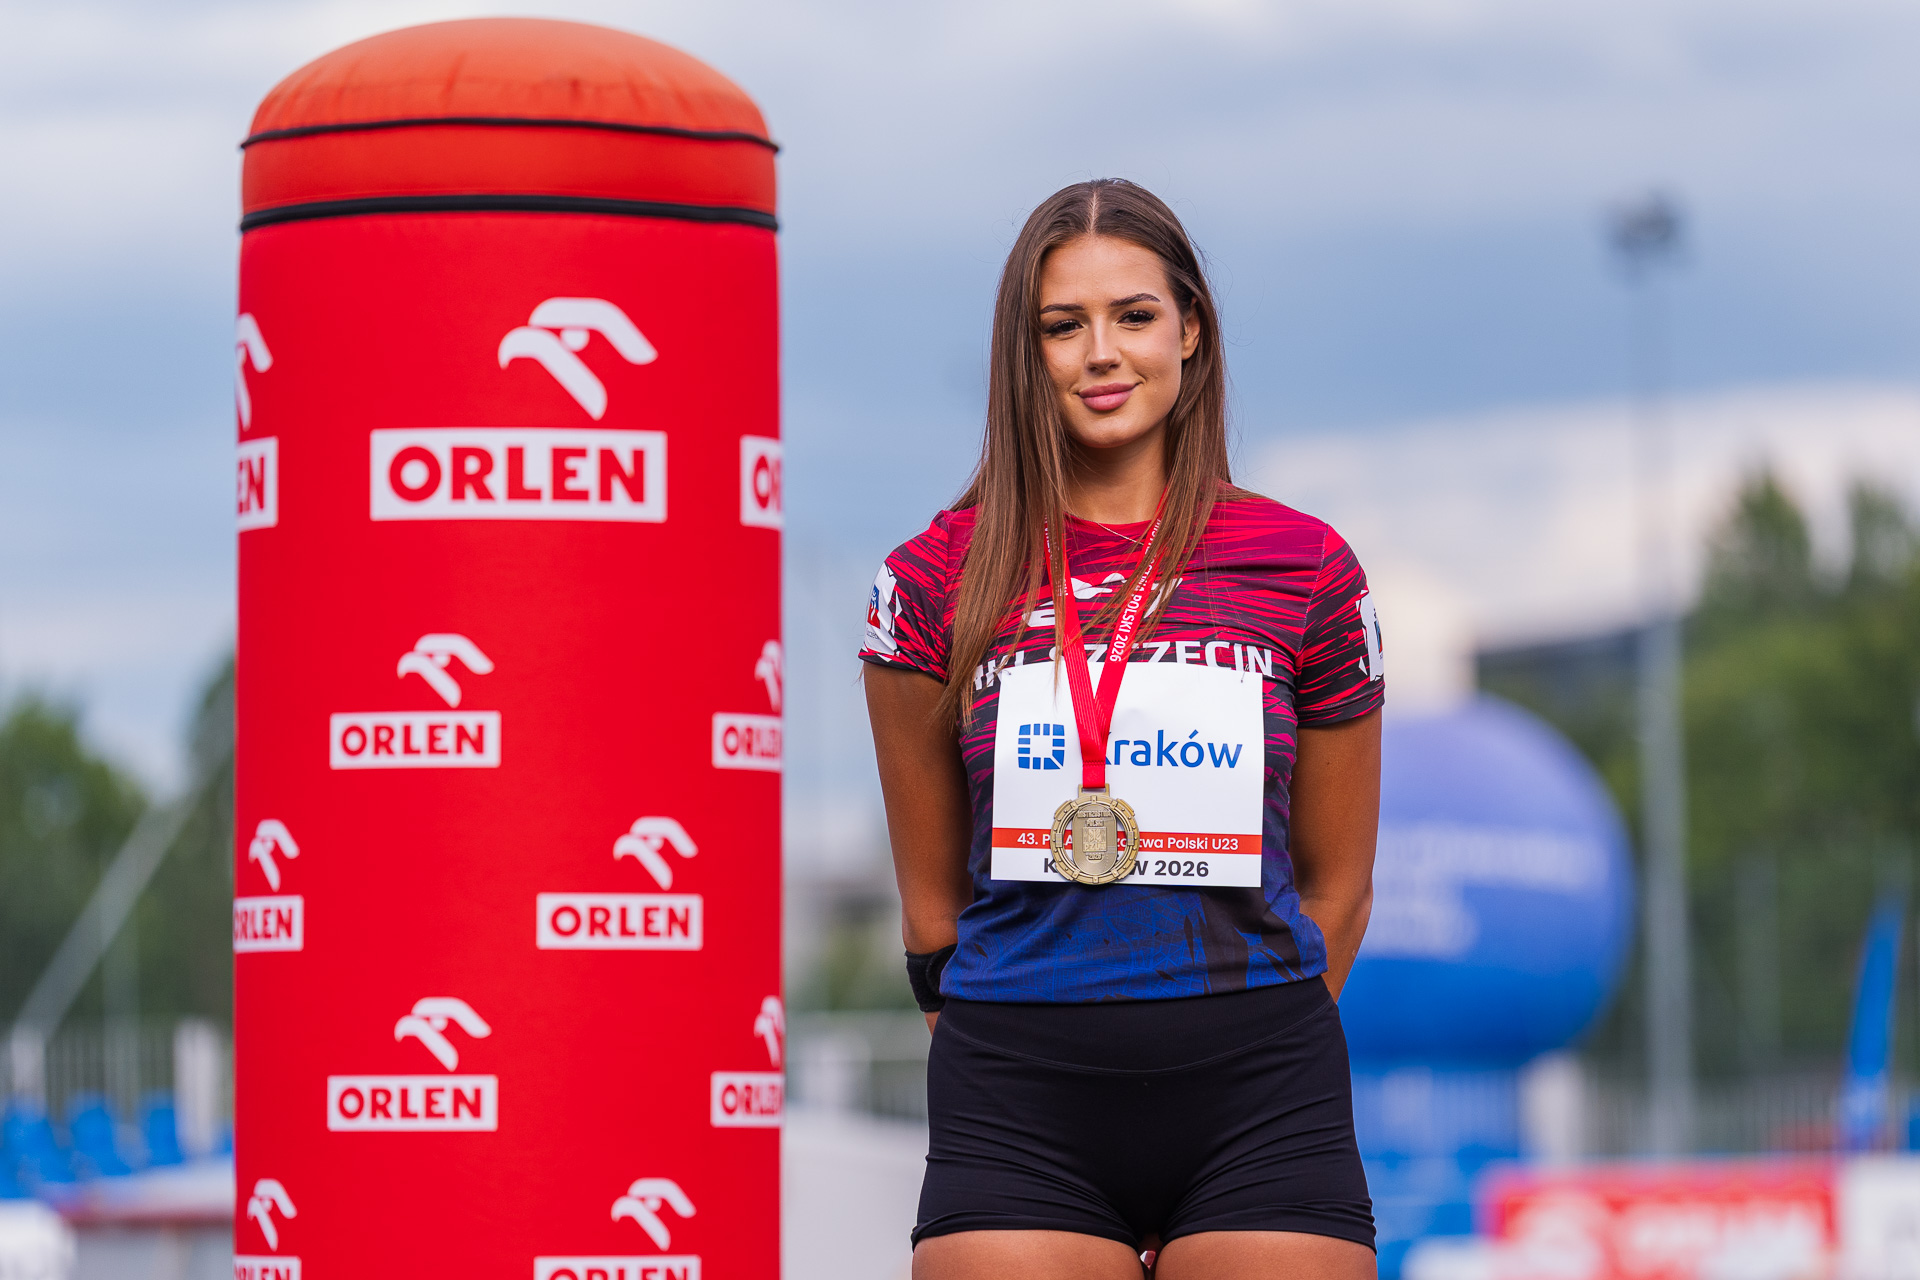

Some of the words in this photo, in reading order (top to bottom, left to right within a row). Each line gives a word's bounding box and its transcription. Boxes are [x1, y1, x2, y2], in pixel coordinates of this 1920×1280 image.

[388, 445, 645, 504] ORLEN
[1117, 594, 1143, 633] POLSKI
[1049, 641, 1275, 678] ZZECIN
[1110, 635, 1129, 662] 2026
[341, 724, 484, 757] ORLEN
[1105, 729, 1243, 768] raków
[1017, 832, 1038, 845] 43.
[1167, 836, 1208, 851] Polski
[1212, 838, 1239, 850] U23
[1155, 860, 1209, 877] 2026
[236, 907, 293, 940] RLEN
[550, 905, 690, 938] ORLEN
[338, 1087, 482, 1120] ORLEN
